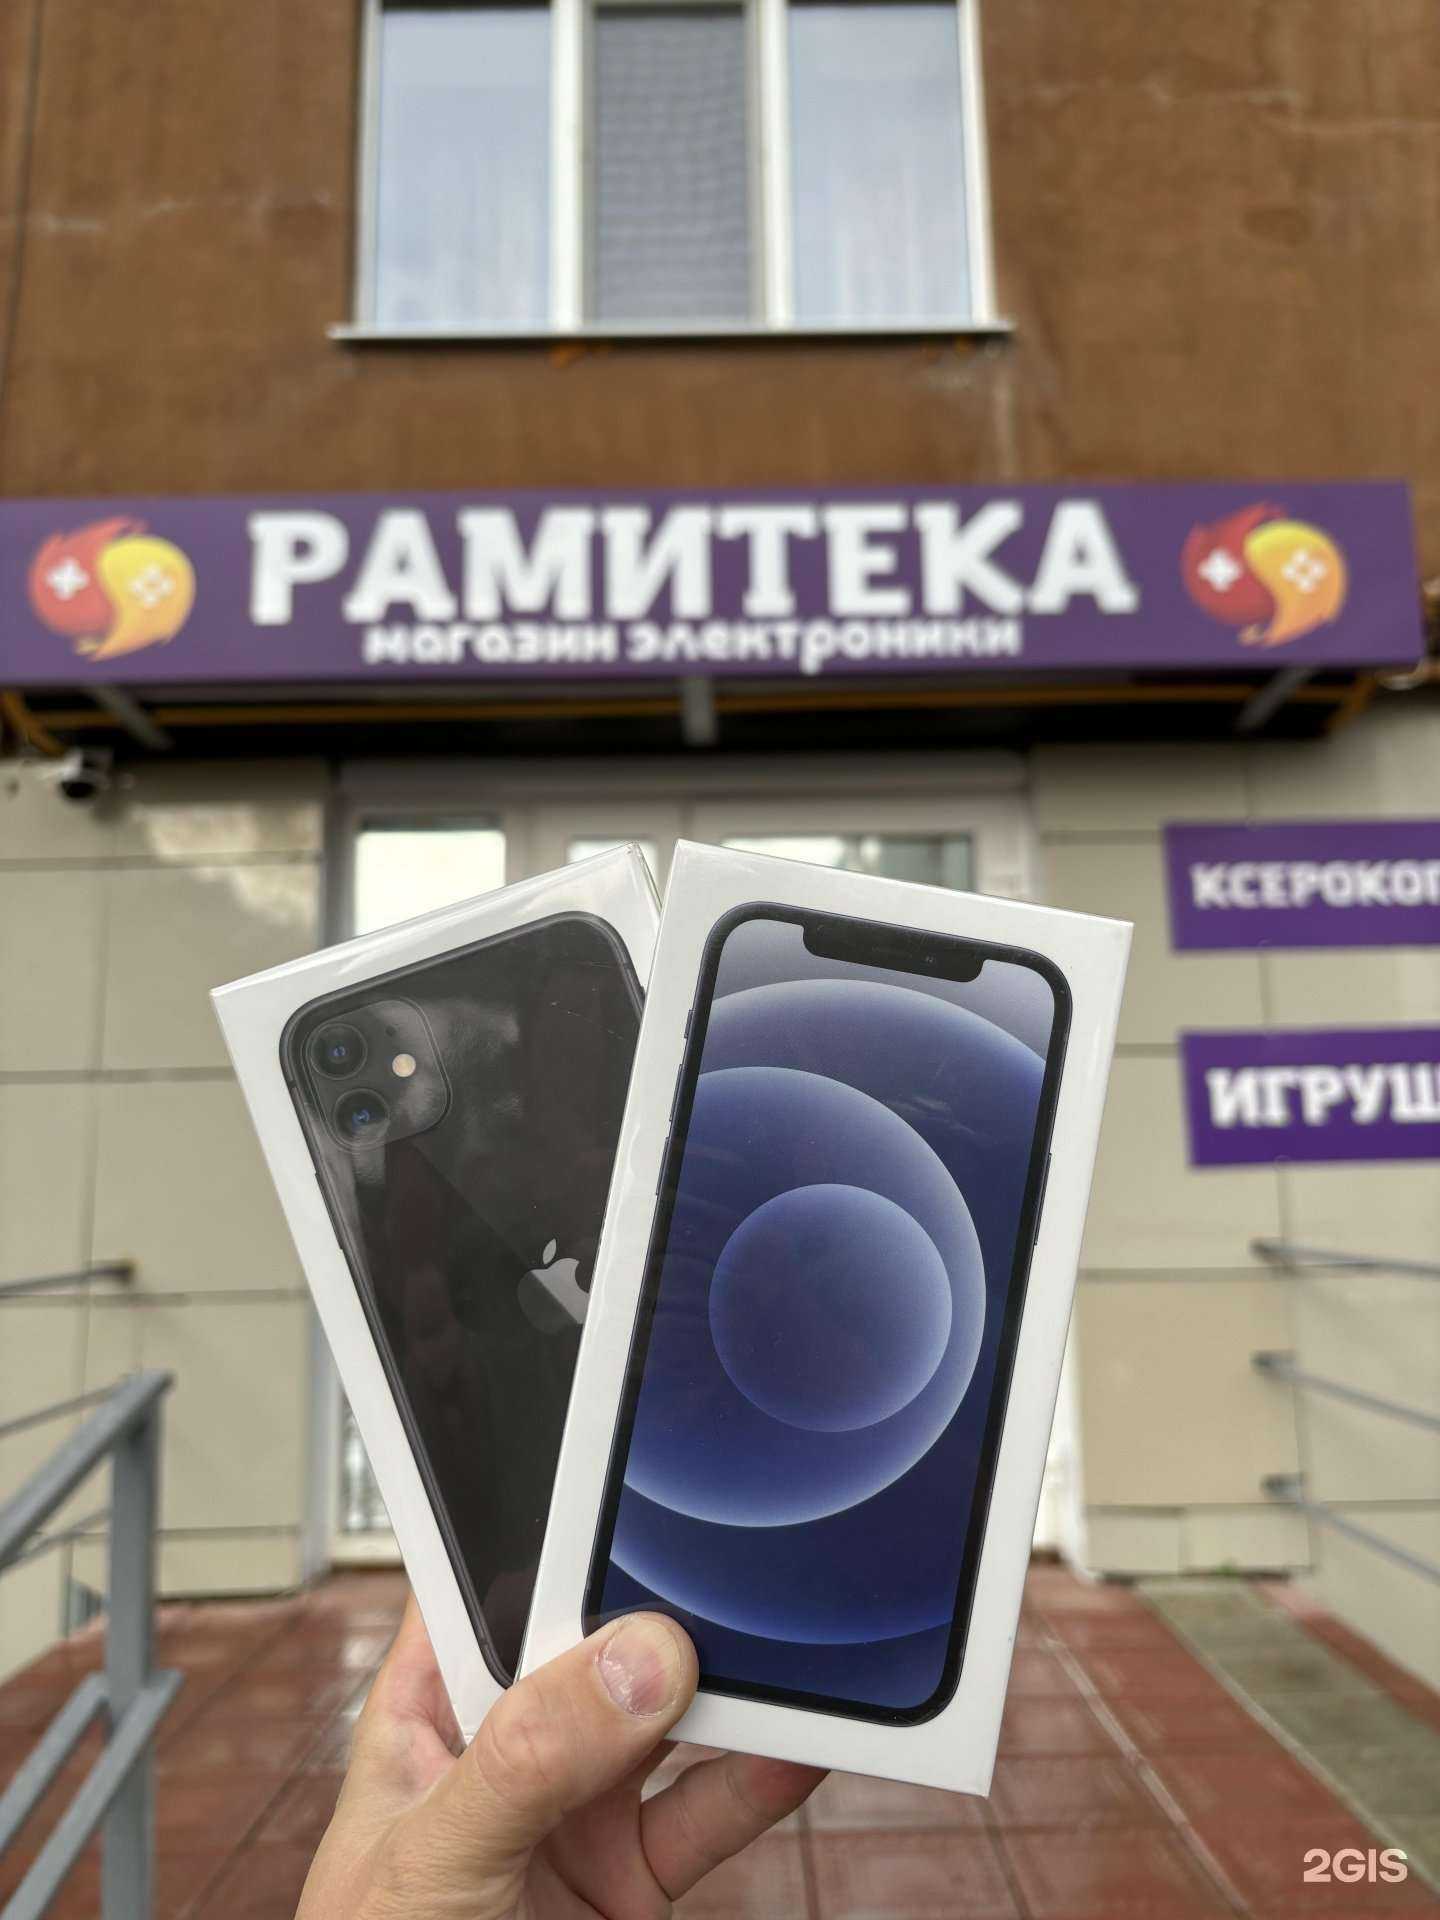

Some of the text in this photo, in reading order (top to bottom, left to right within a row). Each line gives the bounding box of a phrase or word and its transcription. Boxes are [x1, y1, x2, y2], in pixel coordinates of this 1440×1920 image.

[248, 502, 1139, 625] РАМИТЕКА
[364, 618, 1020, 674] магазин электроники
